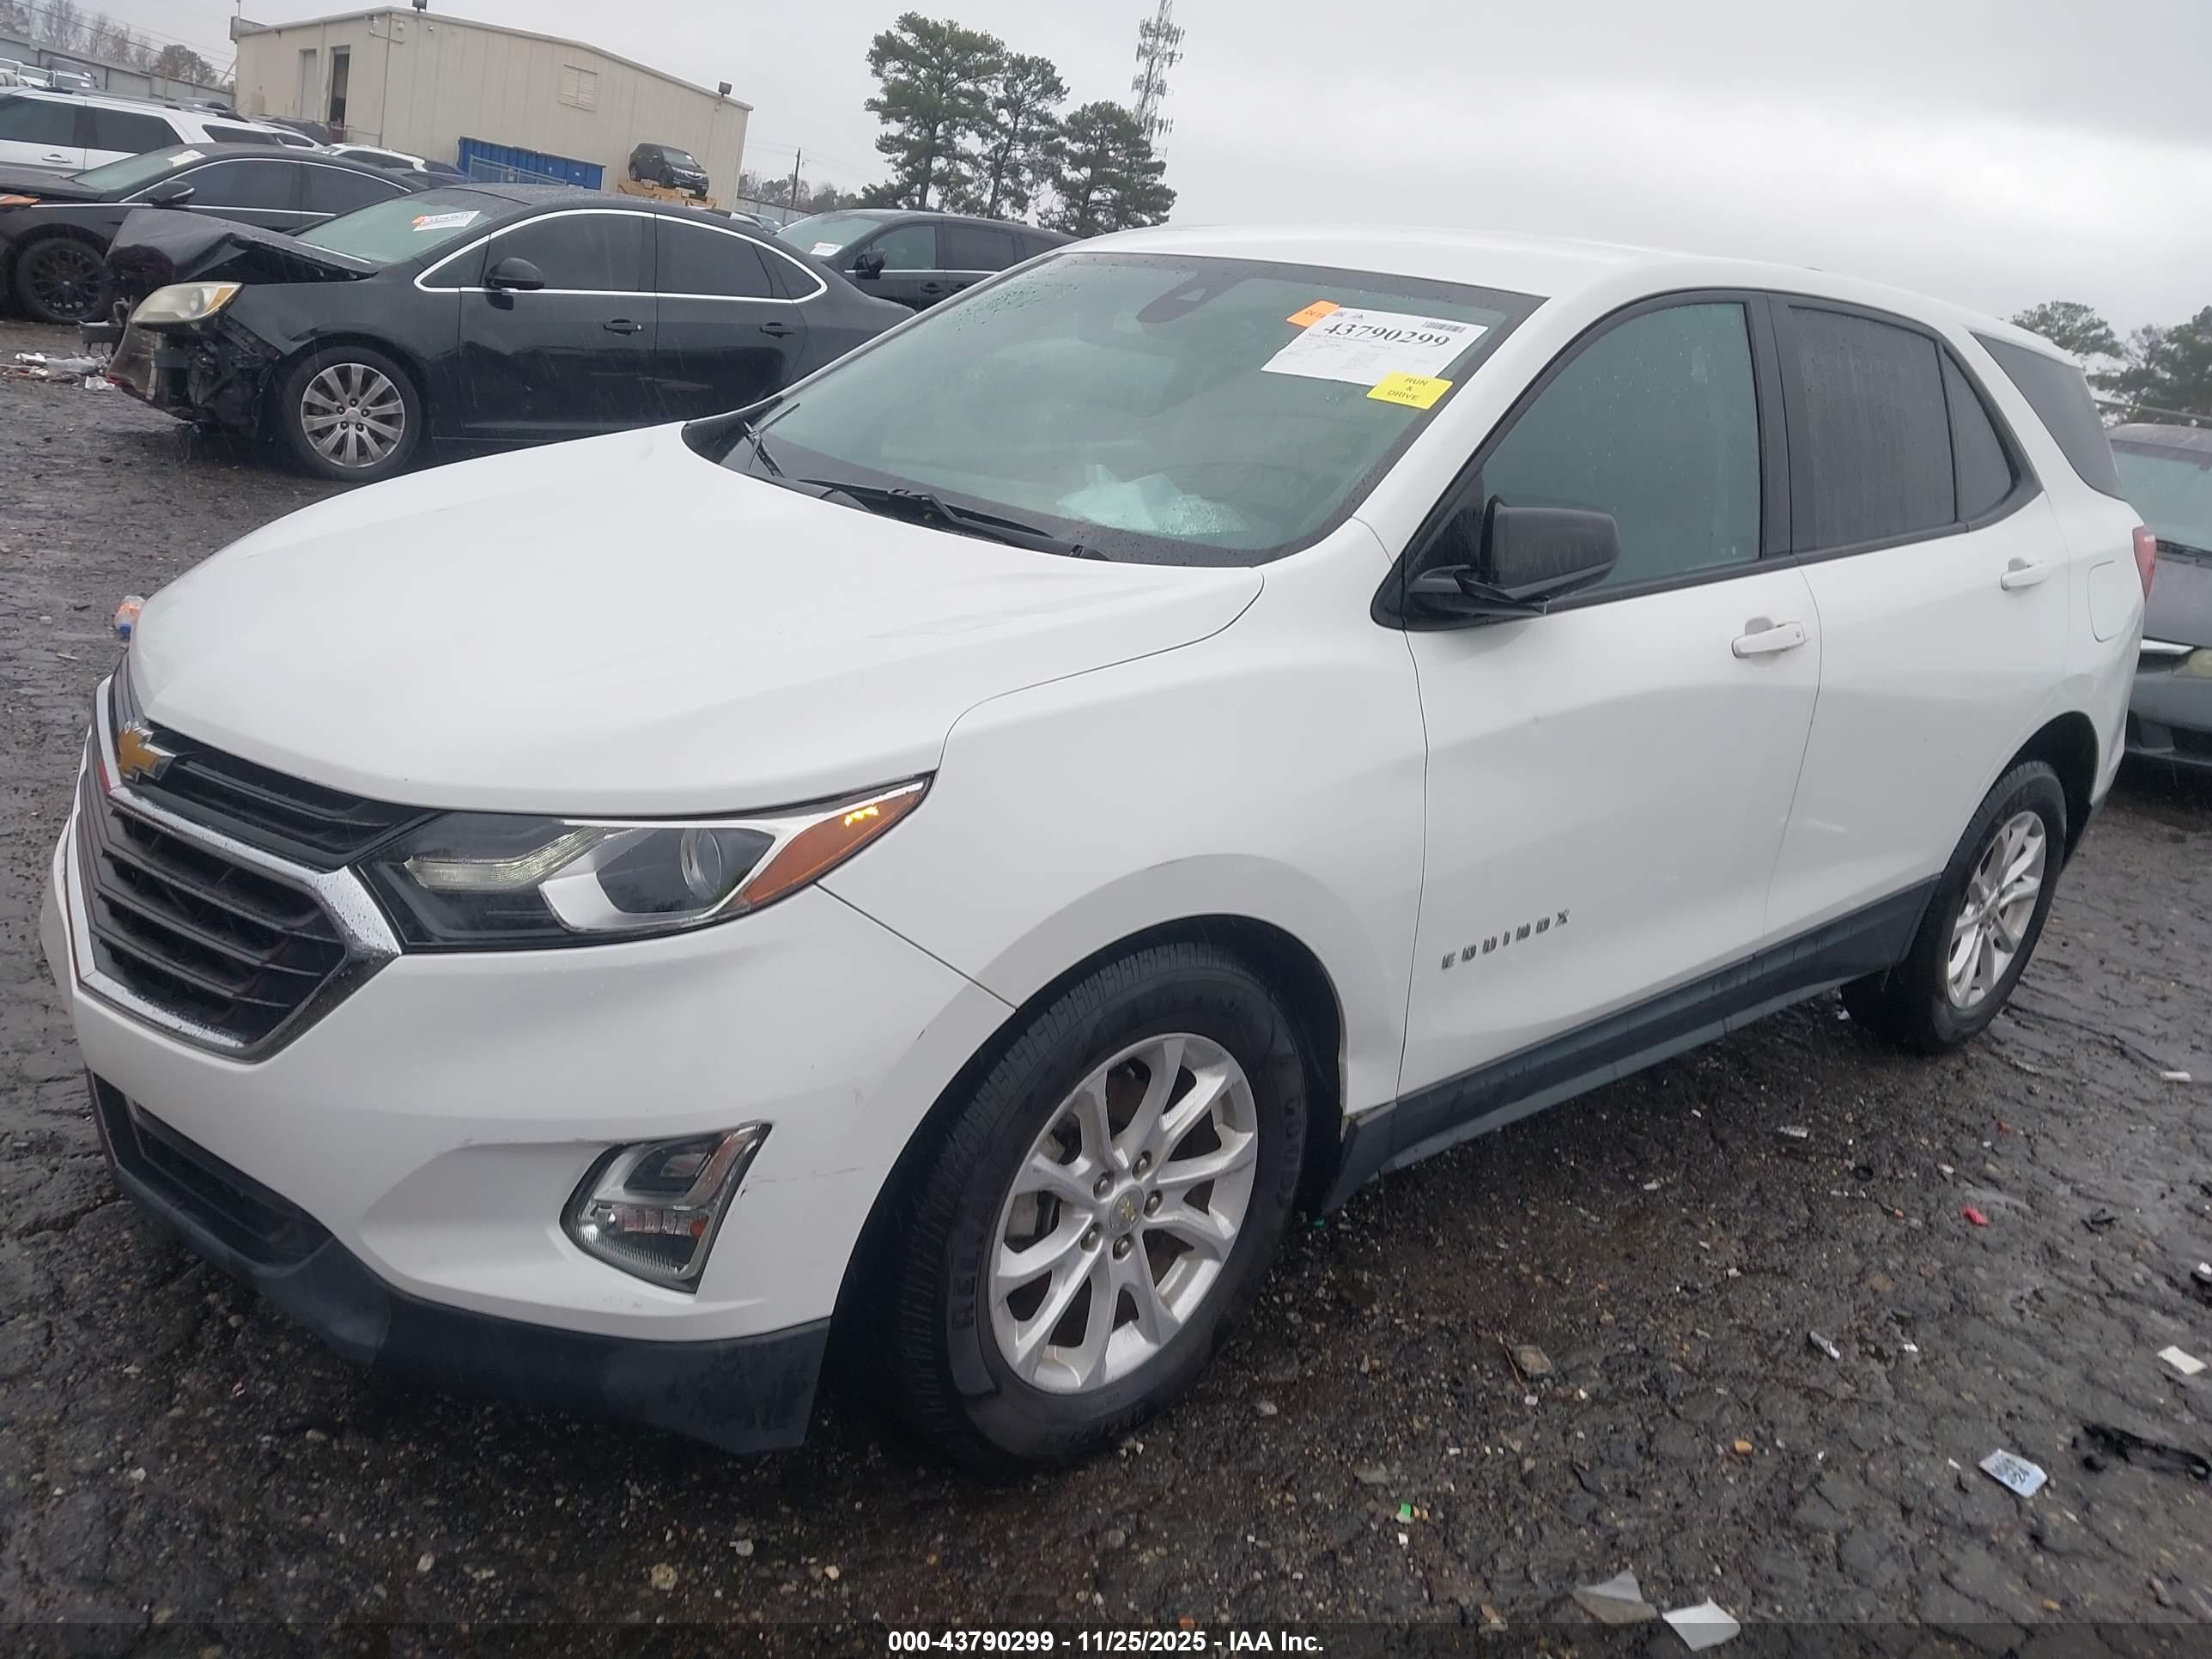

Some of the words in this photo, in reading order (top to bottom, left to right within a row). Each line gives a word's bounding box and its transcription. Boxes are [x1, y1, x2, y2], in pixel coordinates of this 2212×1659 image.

[1323, 322, 1450, 347] 43790299
[1404, 377, 1429, 386] RUN
[1387, 390, 1419, 400] DRIVE
[1442, 909, 1569, 969] EQUINOX
